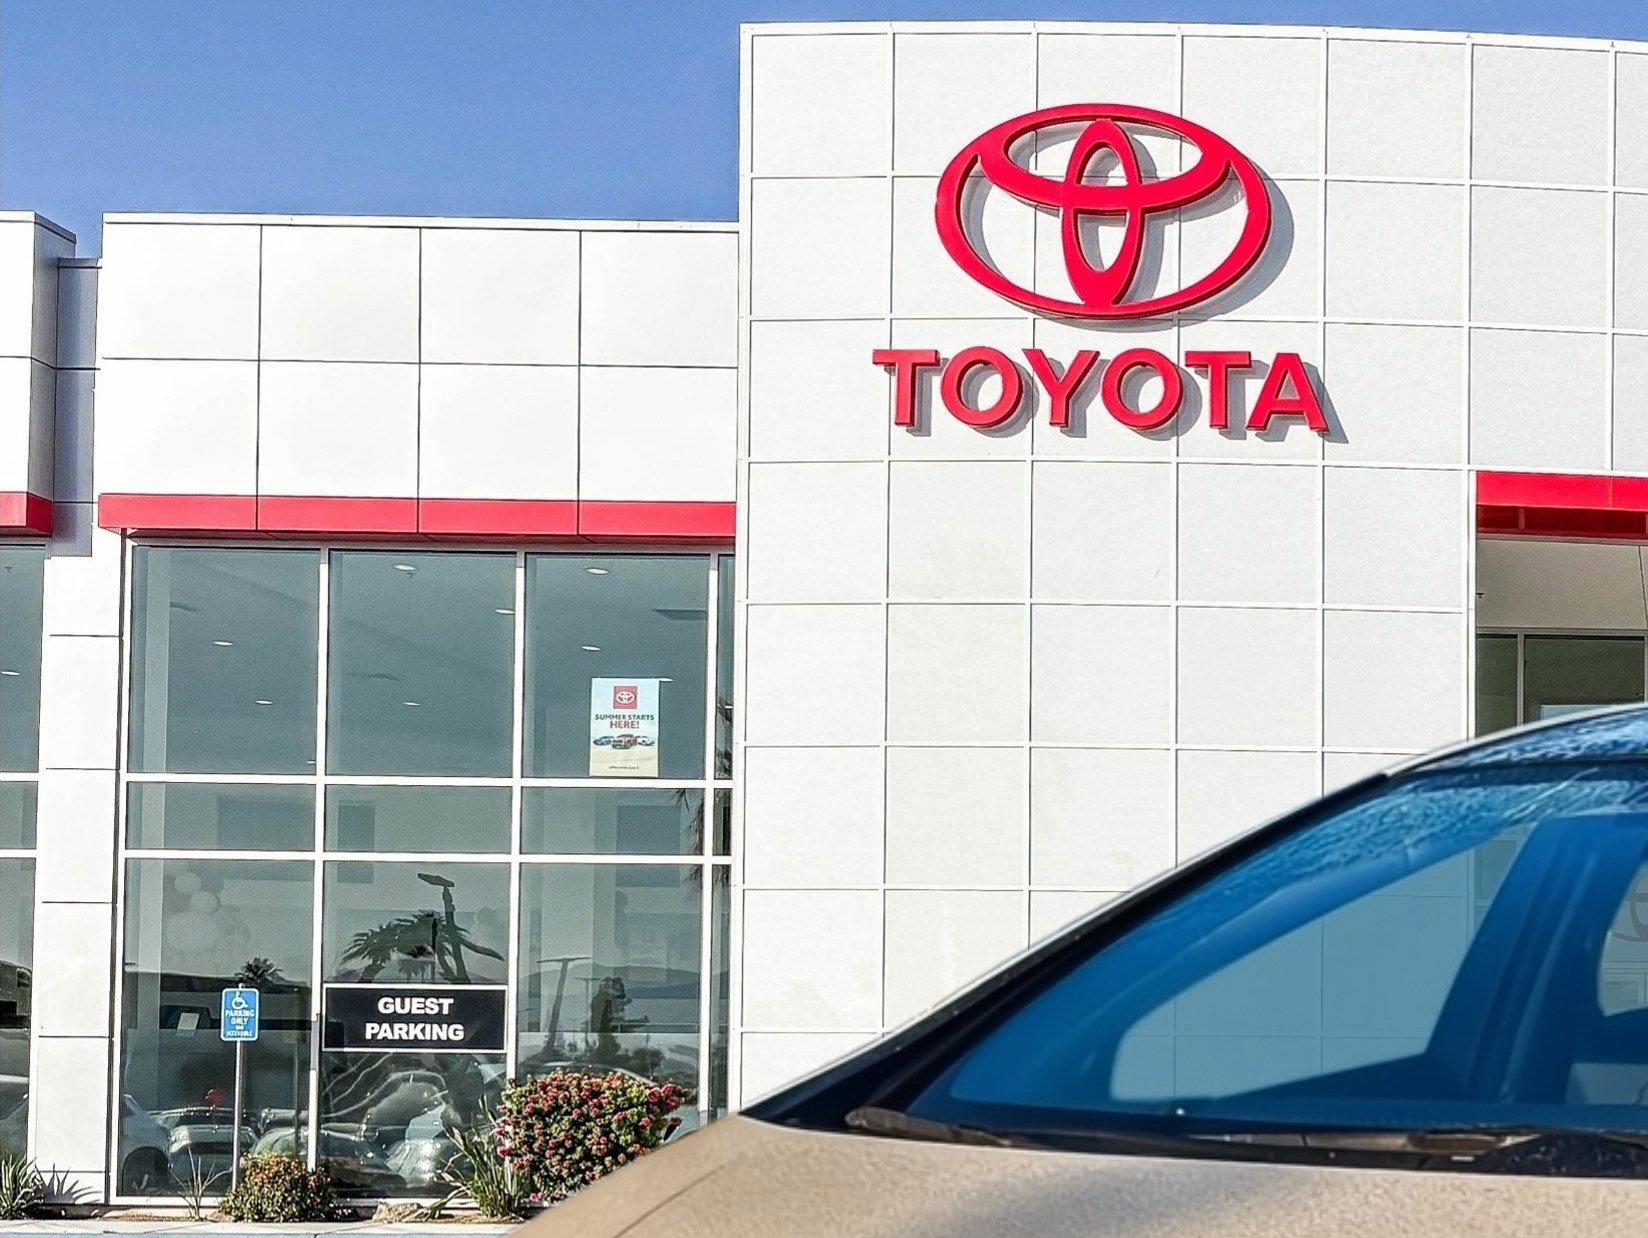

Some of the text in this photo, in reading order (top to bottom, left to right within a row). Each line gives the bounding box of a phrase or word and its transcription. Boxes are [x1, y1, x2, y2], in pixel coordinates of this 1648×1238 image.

[872, 346, 1330, 432] TOYOTA
[609, 720, 640, 729] HERE!
[225, 1009, 255, 1017] PARKING
[377, 997, 454, 1015] GUEST
[365, 1022, 465, 1041] PARKING
